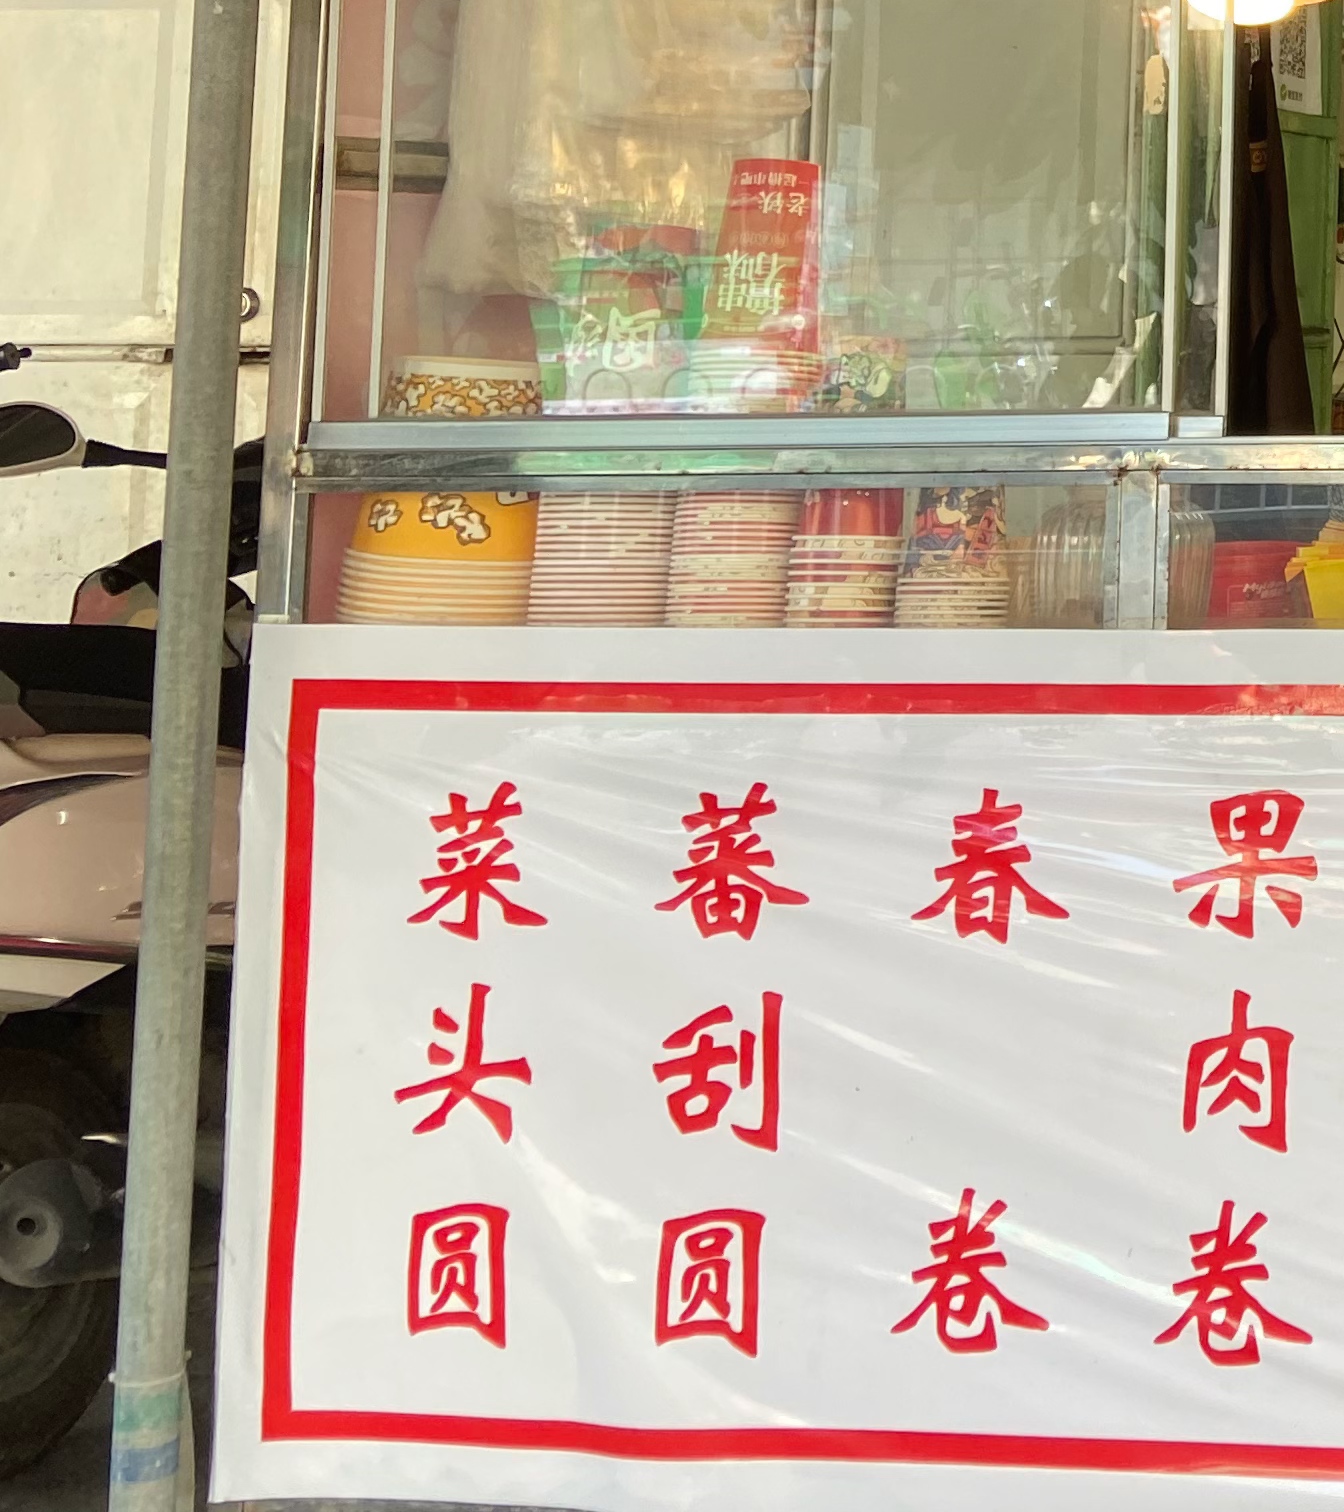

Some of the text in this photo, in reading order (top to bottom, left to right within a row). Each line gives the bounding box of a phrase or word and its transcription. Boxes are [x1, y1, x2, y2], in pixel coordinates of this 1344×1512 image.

[394, 781, 548, 1350] 菜头圆
[1153, 789, 1318, 1366] 果肉卷
